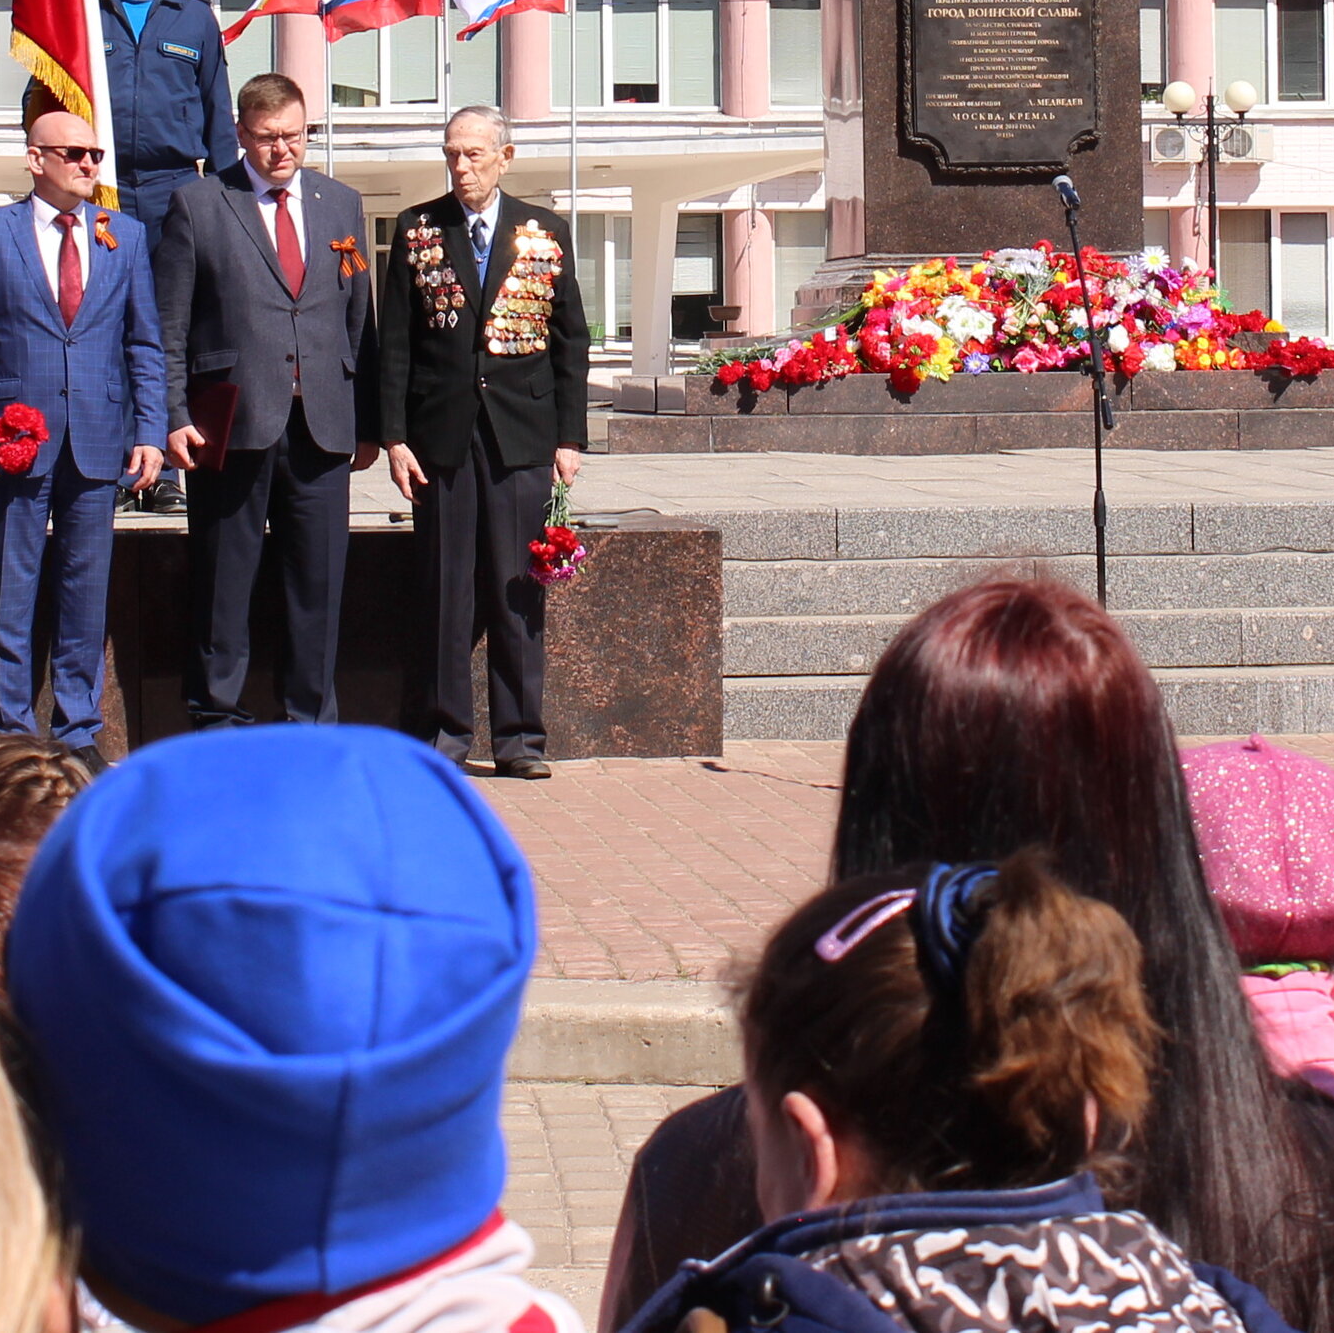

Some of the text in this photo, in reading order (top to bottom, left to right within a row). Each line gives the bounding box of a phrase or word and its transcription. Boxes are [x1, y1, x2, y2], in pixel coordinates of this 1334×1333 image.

[968, 6, 1034, 17] ВОИНСКОЙ
[1037, 98, 1083, 107] МЕДВЕДЕВ
[952, 112, 1056, 121] МОСКВА, КРЕМЛЬ
